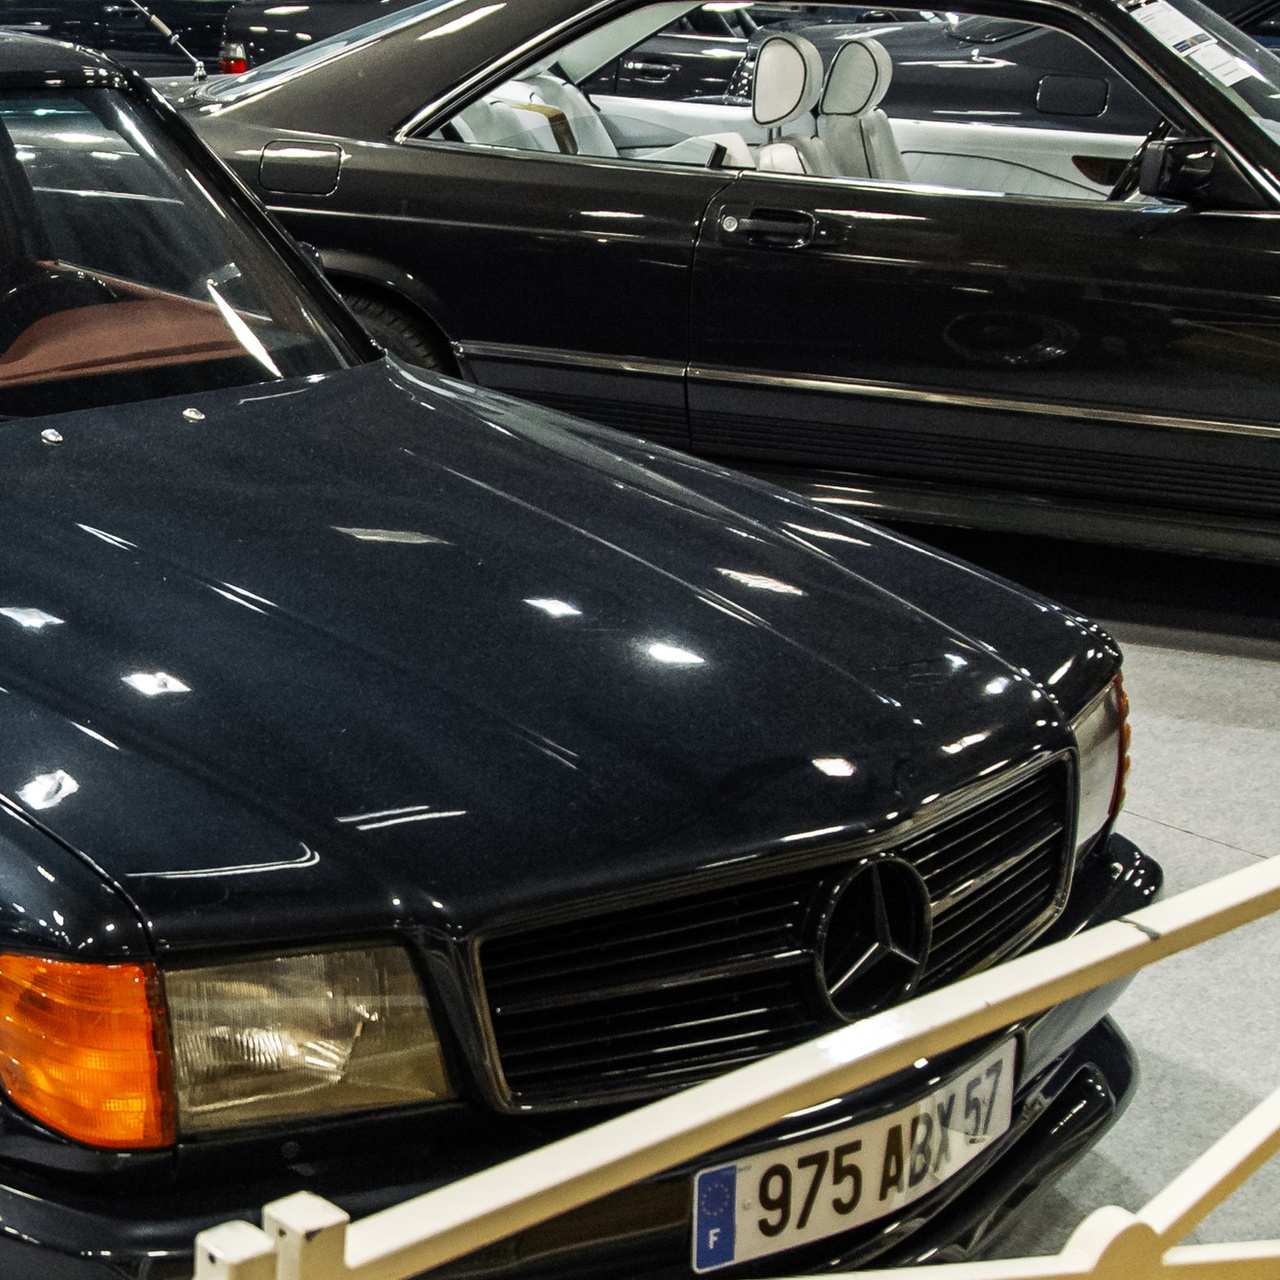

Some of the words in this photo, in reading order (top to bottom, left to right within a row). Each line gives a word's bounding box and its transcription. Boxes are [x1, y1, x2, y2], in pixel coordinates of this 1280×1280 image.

[758, 1139, 862, 1237] 975
[879, 1093, 956, 1201] ABX
[965, 1058, 1004, 1140] 57
[708, 1228, 721, 1250] F
